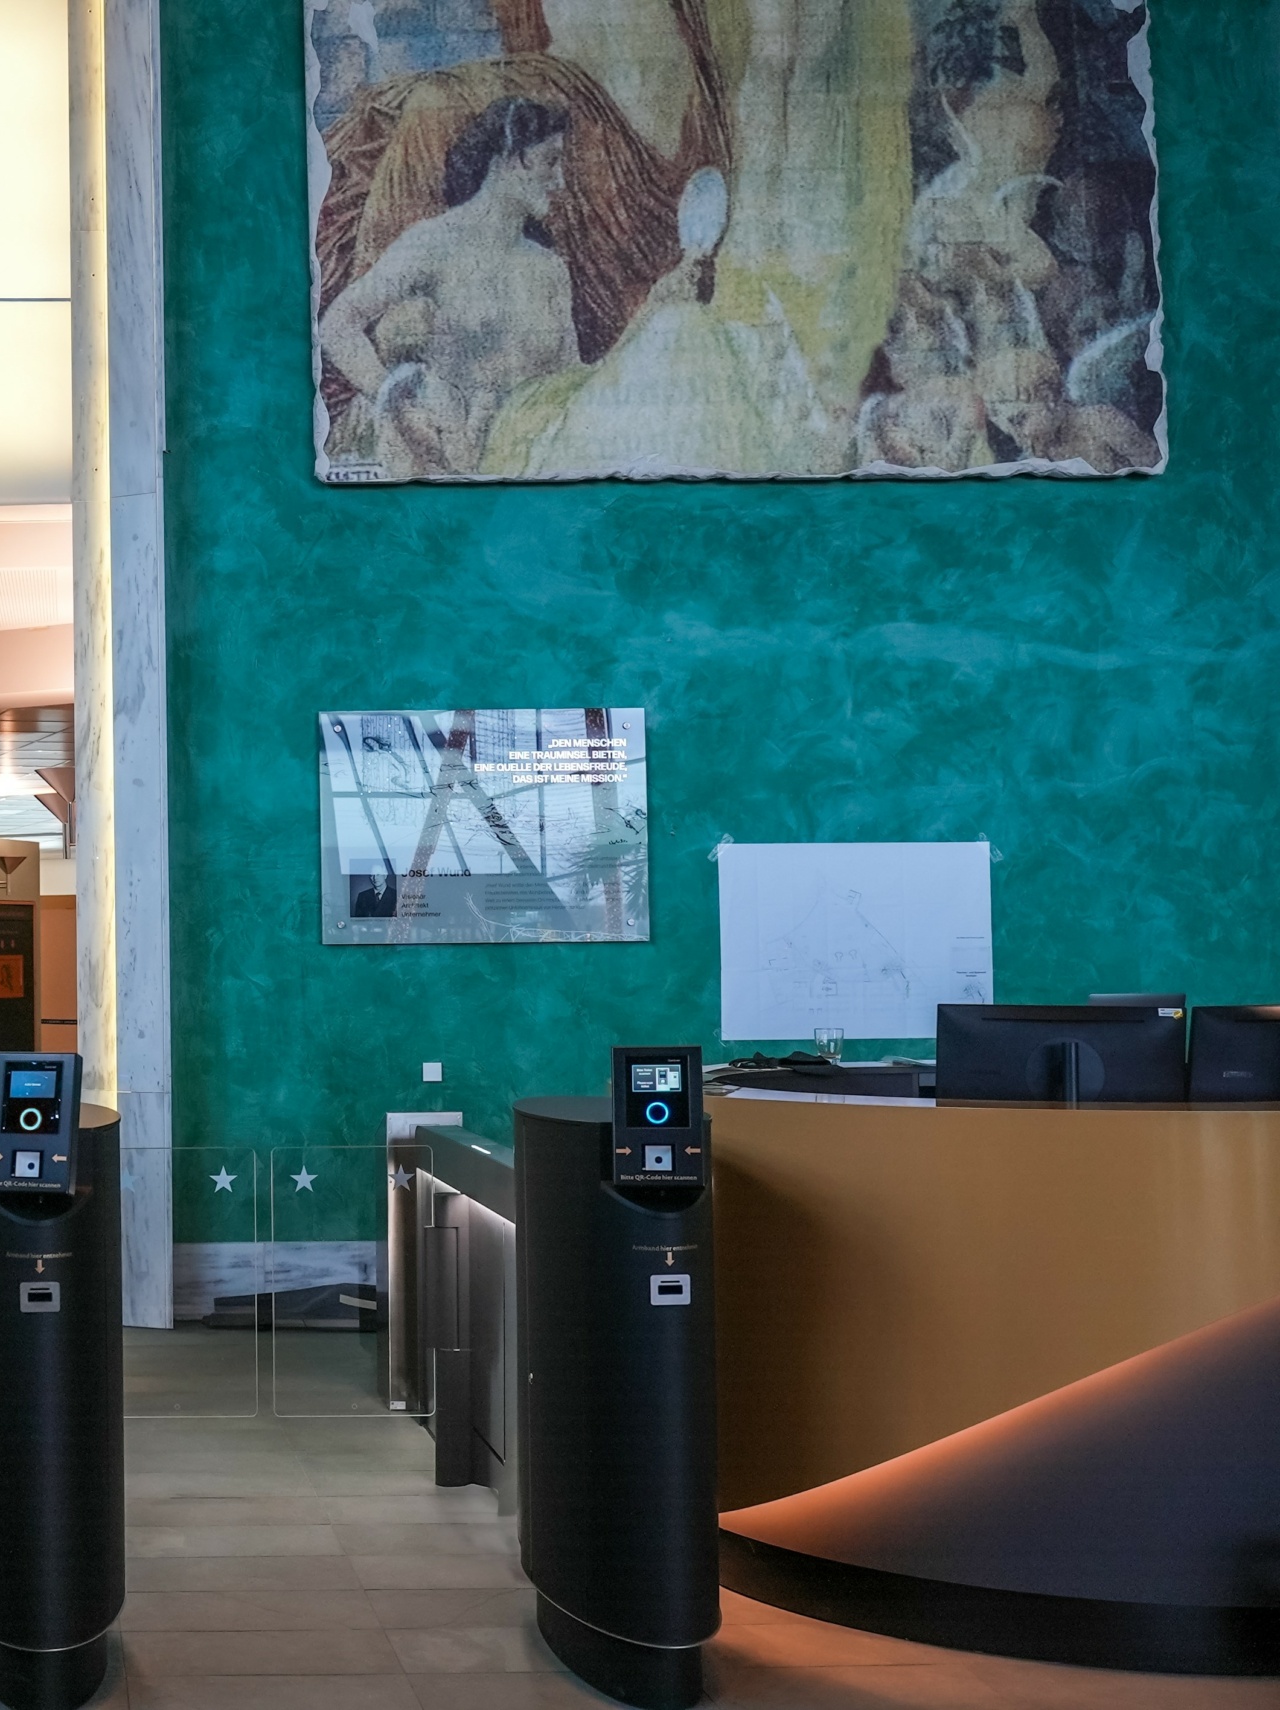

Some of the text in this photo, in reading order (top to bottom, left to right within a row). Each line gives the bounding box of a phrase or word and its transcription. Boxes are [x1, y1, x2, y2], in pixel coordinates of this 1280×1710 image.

[572, 738, 626, 748] MENSCHEN
[509, 750, 627, 760] EINE TRAUMINSEL BIETEN,
[474, 762, 627, 772] EINE QUELLE DER LEBENSFREUDE,
[513, 775, 534, 783] DAS
[534, 775, 550, 783] IST
[550, 774, 580, 783] MEINE
[634, 1174, 661, 1182] QR-Code
[3, 1180, 27, 1188] QR-Code
